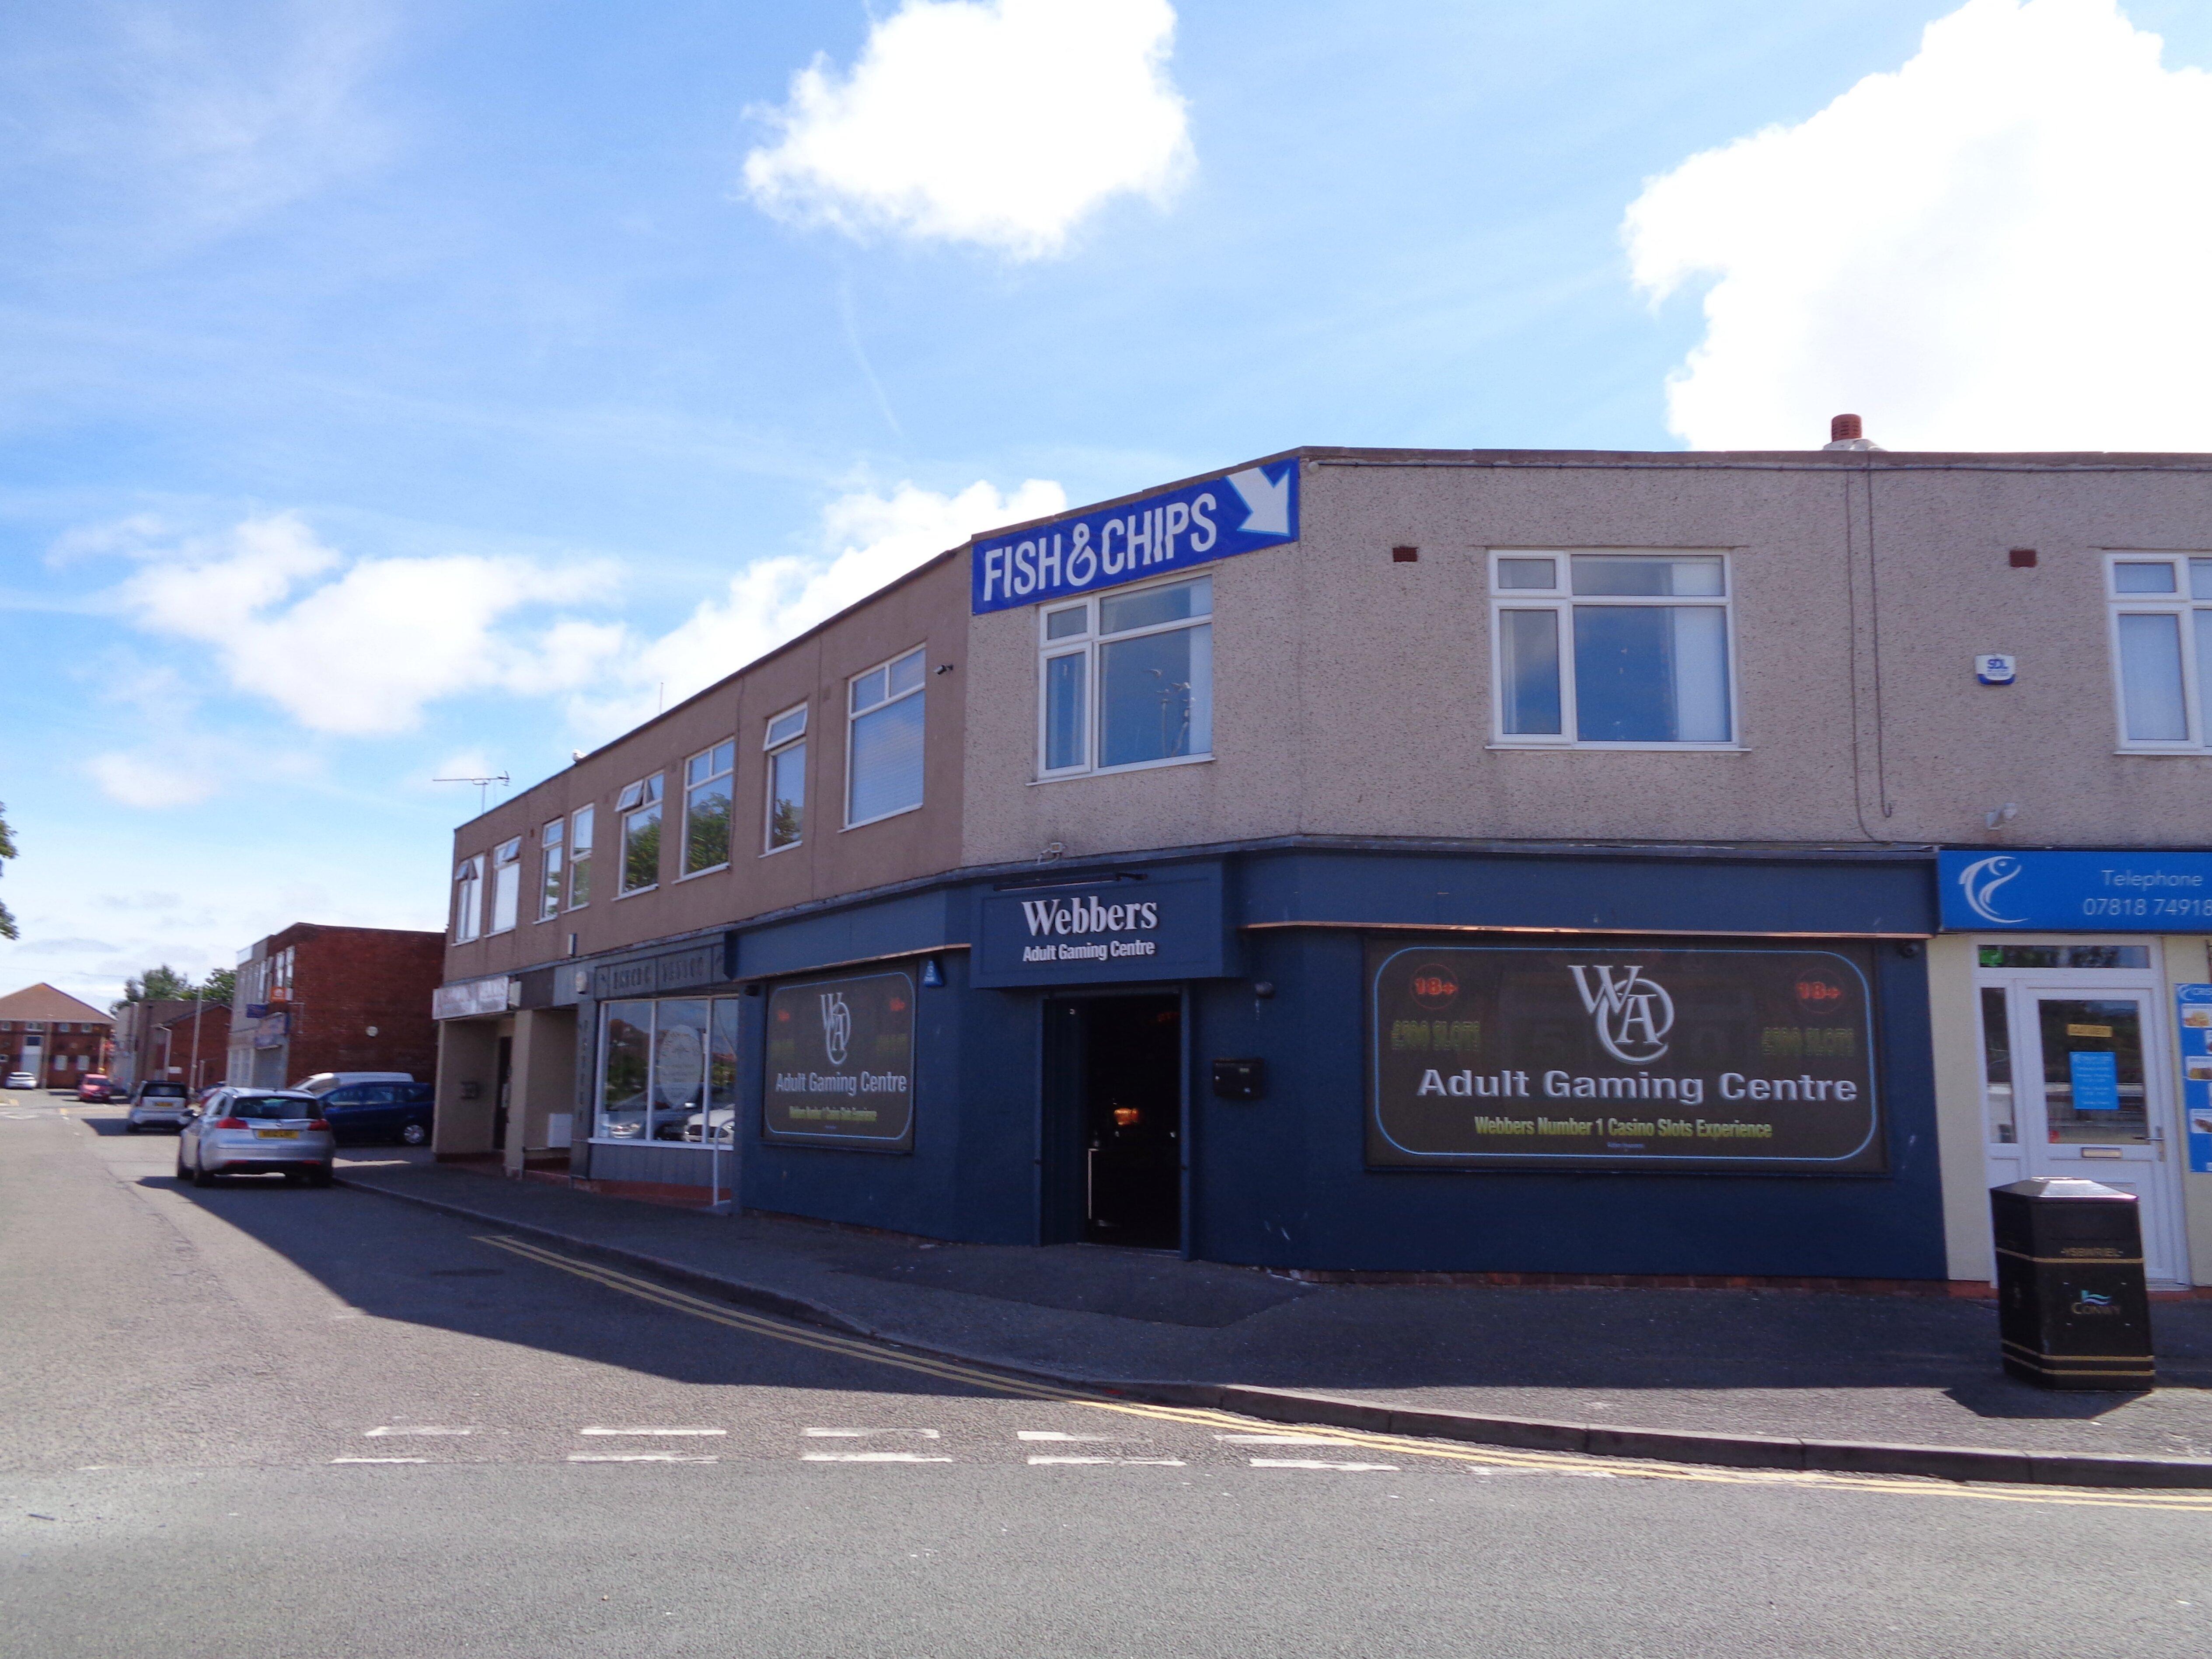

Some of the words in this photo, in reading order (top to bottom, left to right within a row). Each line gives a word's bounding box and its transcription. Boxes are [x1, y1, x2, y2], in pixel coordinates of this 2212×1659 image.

[984, 534, 1061, 601] FISH
[1066, 523, 1097, 586] &
[1101, 493, 1217, 575] CHIPS
[2100, 869, 2203, 892] Telephone
[1021, 896, 1158, 936] Webbers
[2083, 898, 2147, 915] 07818
[1022, 945, 1057, 962] Adult
[1058, 942, 1108, 961] Gaming
[1110, 939, 1155, 957] Centre
[1415, 977, 1459, 996] 18+
[1796, 981, 1842, 999] 18+
[775, 1072, 806, 1092] Adult
[809, 1071, 857, 1096] Gaming
[861, 1070, 907, 1091] Centre
[1416, 1069, 1530, 1097] Adult
[1542, 1070, 1703, 1105] Gaming
[1718, 1072, 1857, 1101] Centre
[1474, 1116, 1535, 1135] Webbers
[1537, 1117, 1593, 1136] Number
[1595, 1118, 1604, 1136] 1
[1608, 1118, 1655, 1136] Casino
[1657, 1118, 1693, 1137] Slots
[1696, 1119, 1773, 1140] Experience
